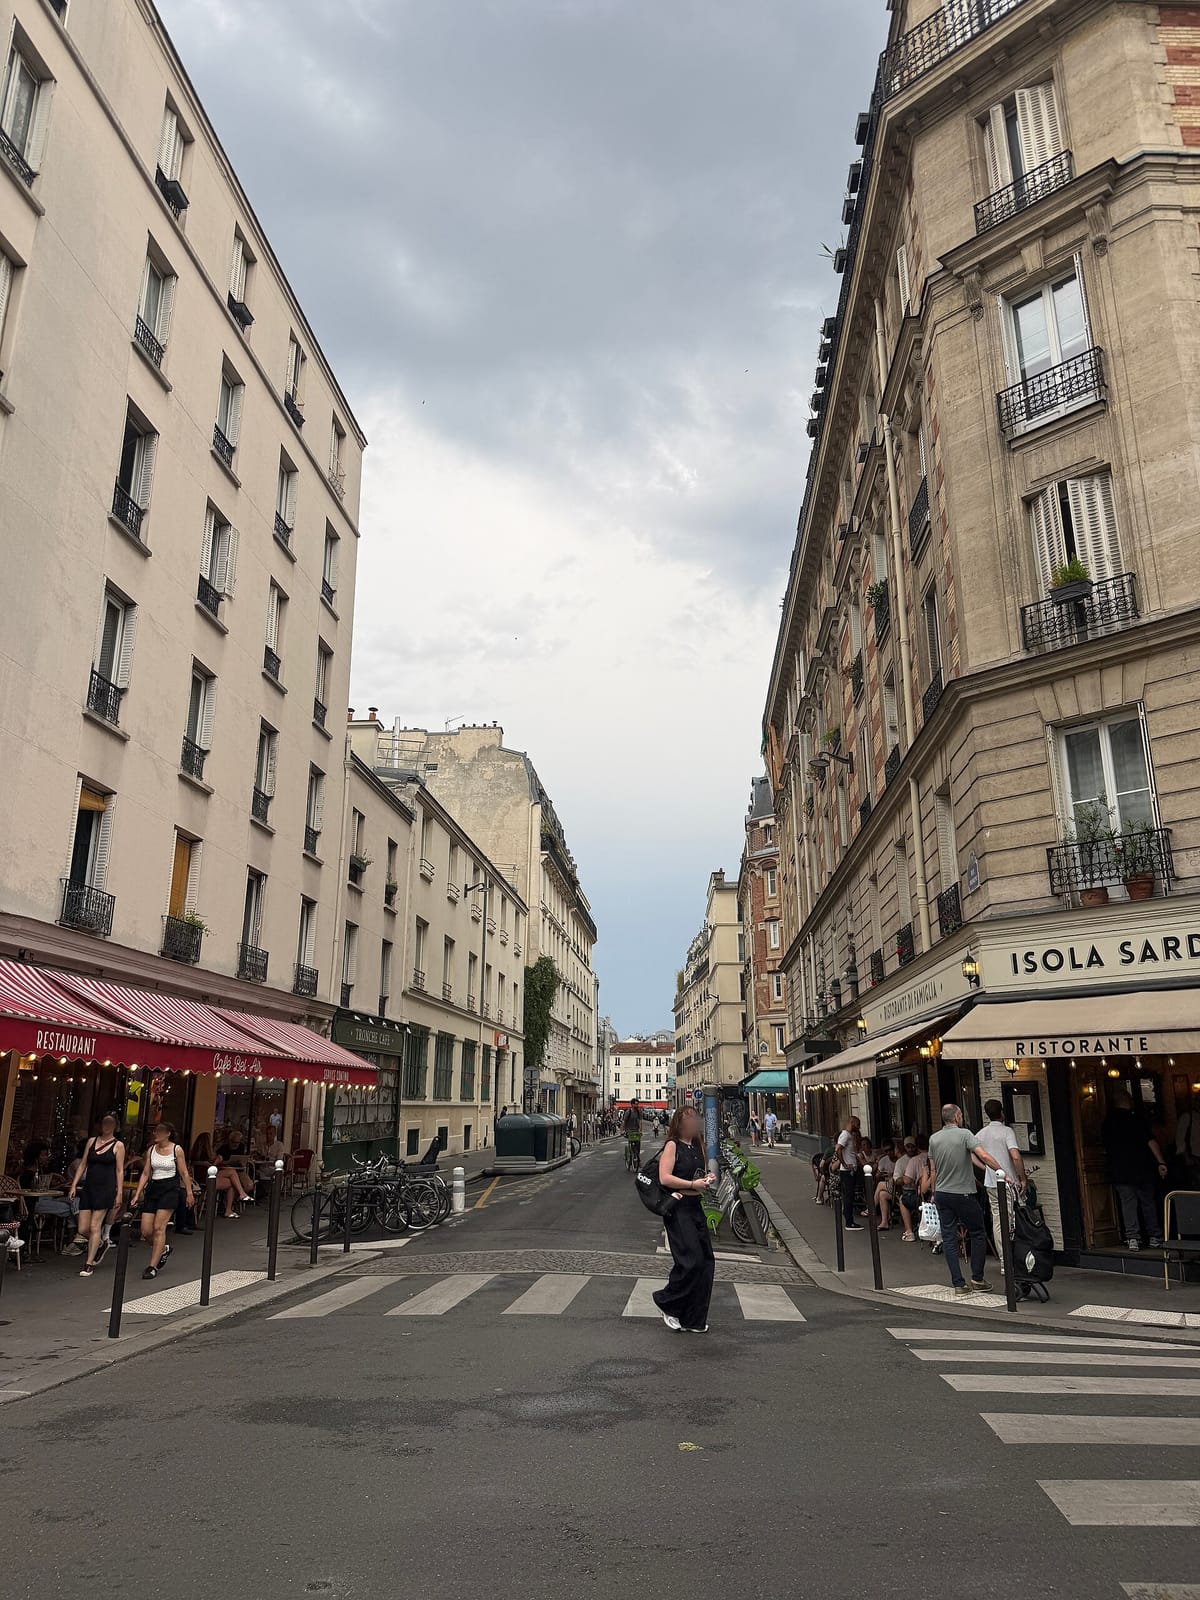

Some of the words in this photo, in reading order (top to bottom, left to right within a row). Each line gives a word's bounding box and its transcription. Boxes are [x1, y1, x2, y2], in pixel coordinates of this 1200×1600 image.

[1011, 945, 1104, 976] ISOLA
[913, 981, 938, 1009] FAMIGLIA
[36, 1030, 97, 1056] RESTAURANT
[1016, 1037, 1148, 1056] RISTORANTE
[213, 1052, 232, 1074] Café
